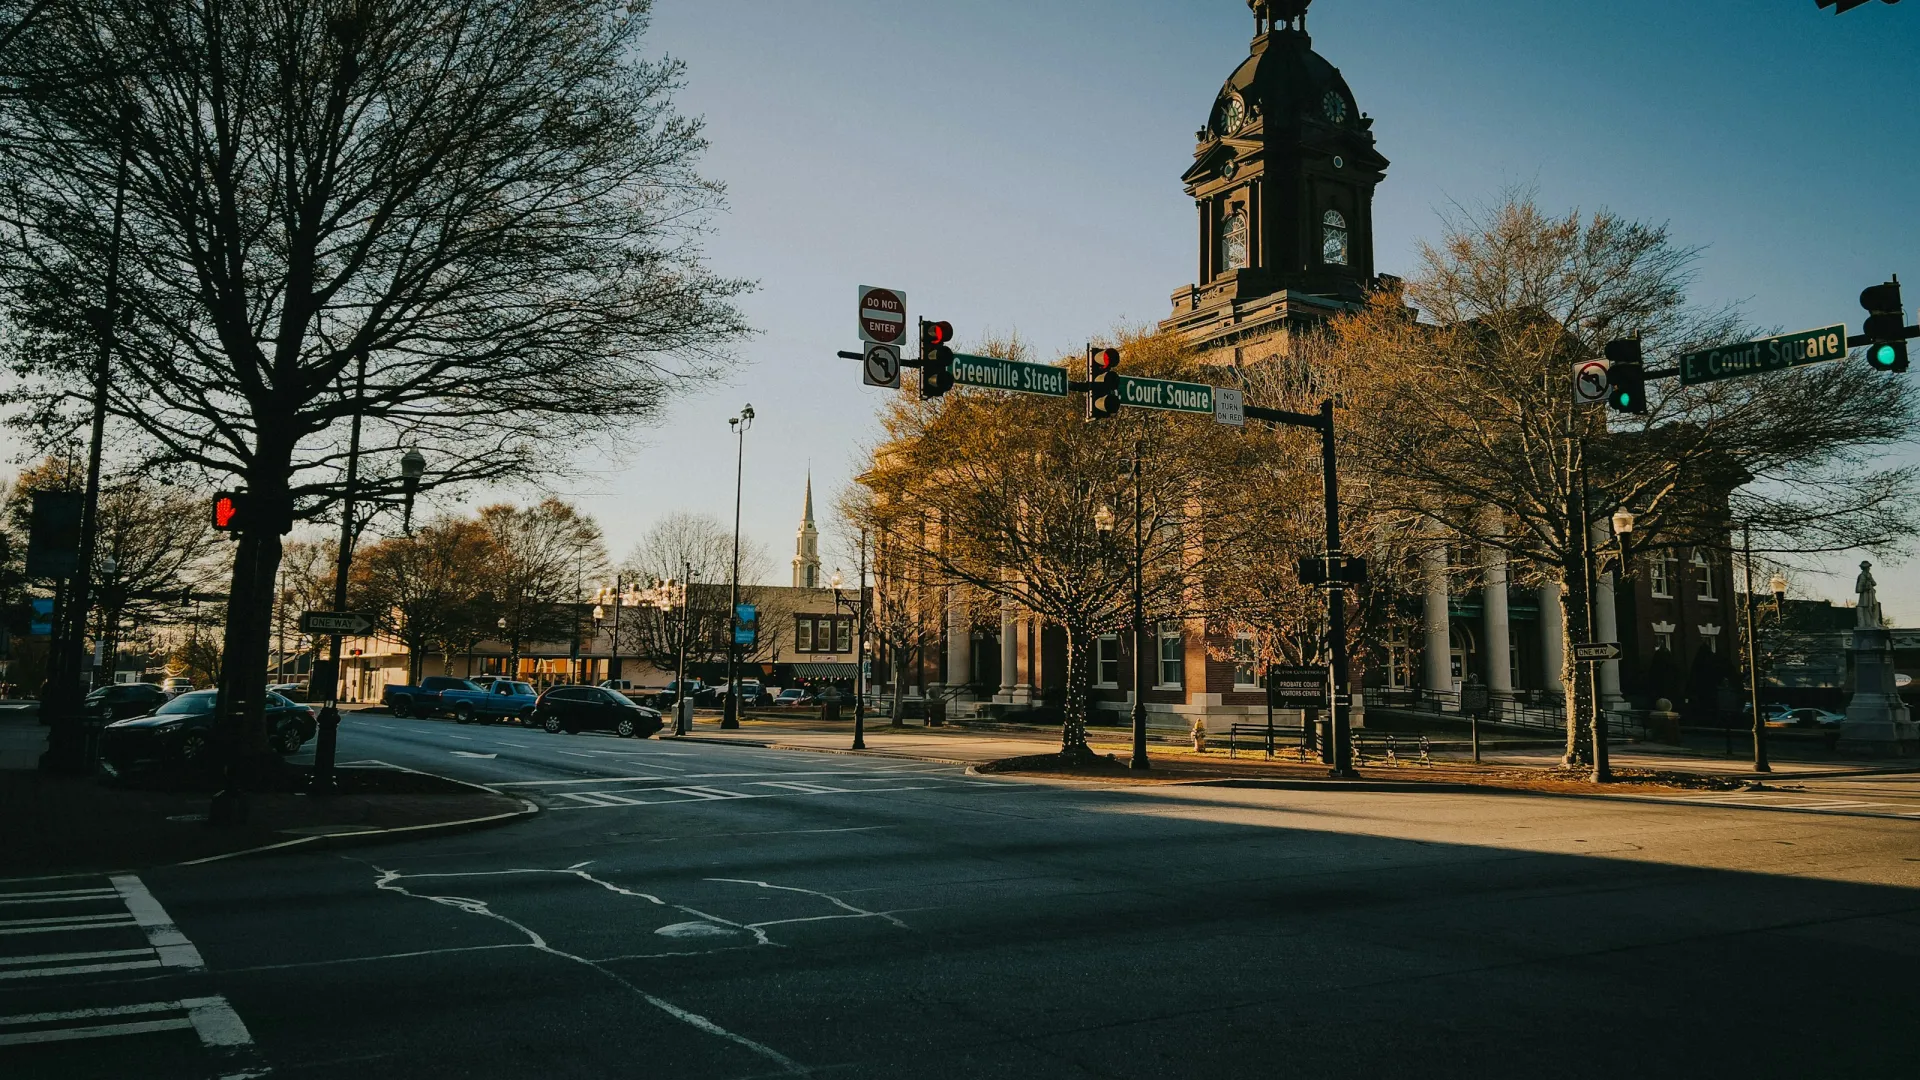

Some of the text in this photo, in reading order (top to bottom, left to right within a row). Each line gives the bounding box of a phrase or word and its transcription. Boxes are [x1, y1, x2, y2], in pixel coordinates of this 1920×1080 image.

[868, 298, 898, 310] DO NOT
[870, 322, 896, 333] ENTER
[1688, 334, 1838, 378] E. Court Square
[952, 358, 1062, 392] Greenville Street
[1126, 380, 1162, 404] Court
[1166, 384, 1208, 408] Square
[1224, 392, 1234, 400] NO
[1221, 402, 1238, 410] TURN
[1230, 414, 1242, 422] RED
[312, 618, 354, 628] ONE WAY
